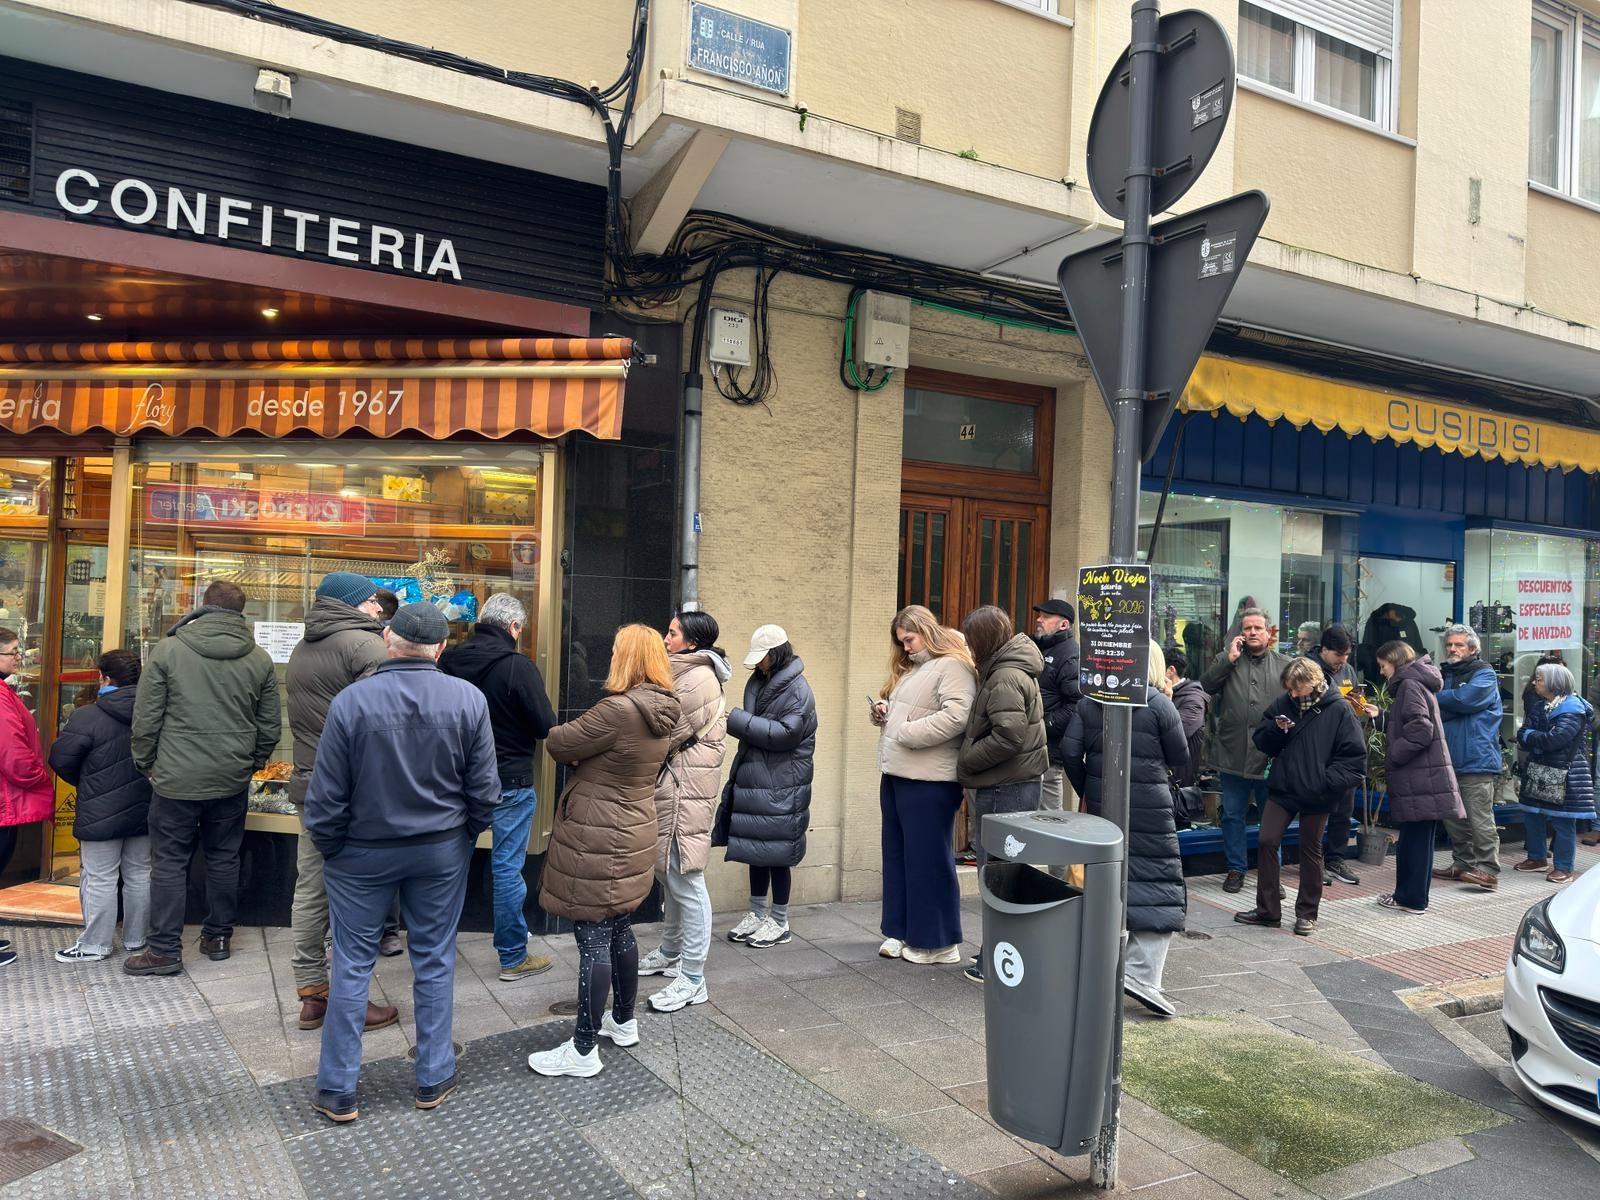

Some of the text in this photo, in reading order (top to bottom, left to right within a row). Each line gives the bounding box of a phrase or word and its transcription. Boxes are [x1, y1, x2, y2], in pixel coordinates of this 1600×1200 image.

[721, 30, 744, 44] CALLE
[751, 39, 765, 50] RUA
[697, 48, 752, 76] FRANCISCO
[55, 168, 462, 280] CONFITERIA
[247, 390, 404, 417] desde 1967
[960, 425, 975, 439] 44
[1388, 400, 1540, 454] CUSIBISI
[1112, 569, 1147, 587] Vieja
[1518, 579, 1572, 593] DESCUENTOS
[1519, 603, 1572, 617] ESPECIALES
[1518, 626, 1572, 640] DE NAVIDAD
